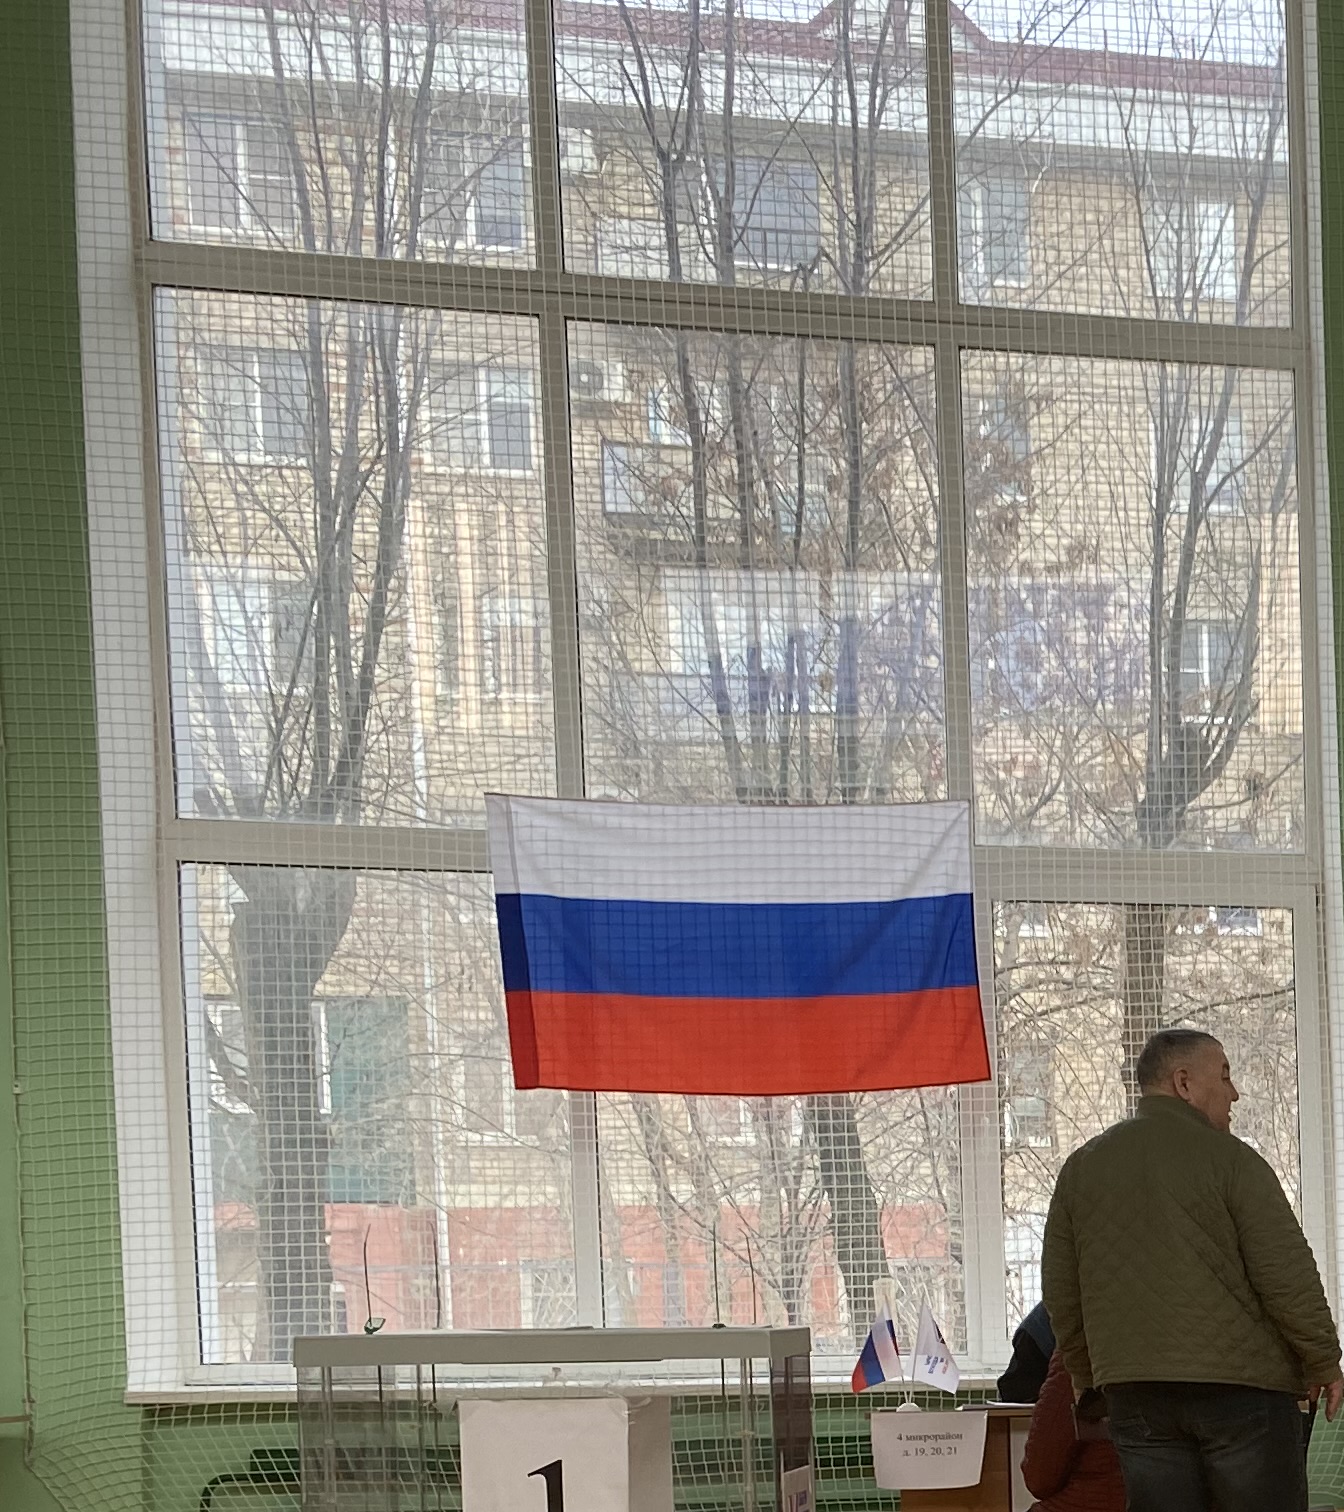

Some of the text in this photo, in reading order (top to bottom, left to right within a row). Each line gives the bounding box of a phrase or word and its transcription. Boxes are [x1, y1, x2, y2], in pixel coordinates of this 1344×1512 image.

[896, 1431, 963, 1443] 4 микрорайон
[946, 1446, 957, 1456] 21
